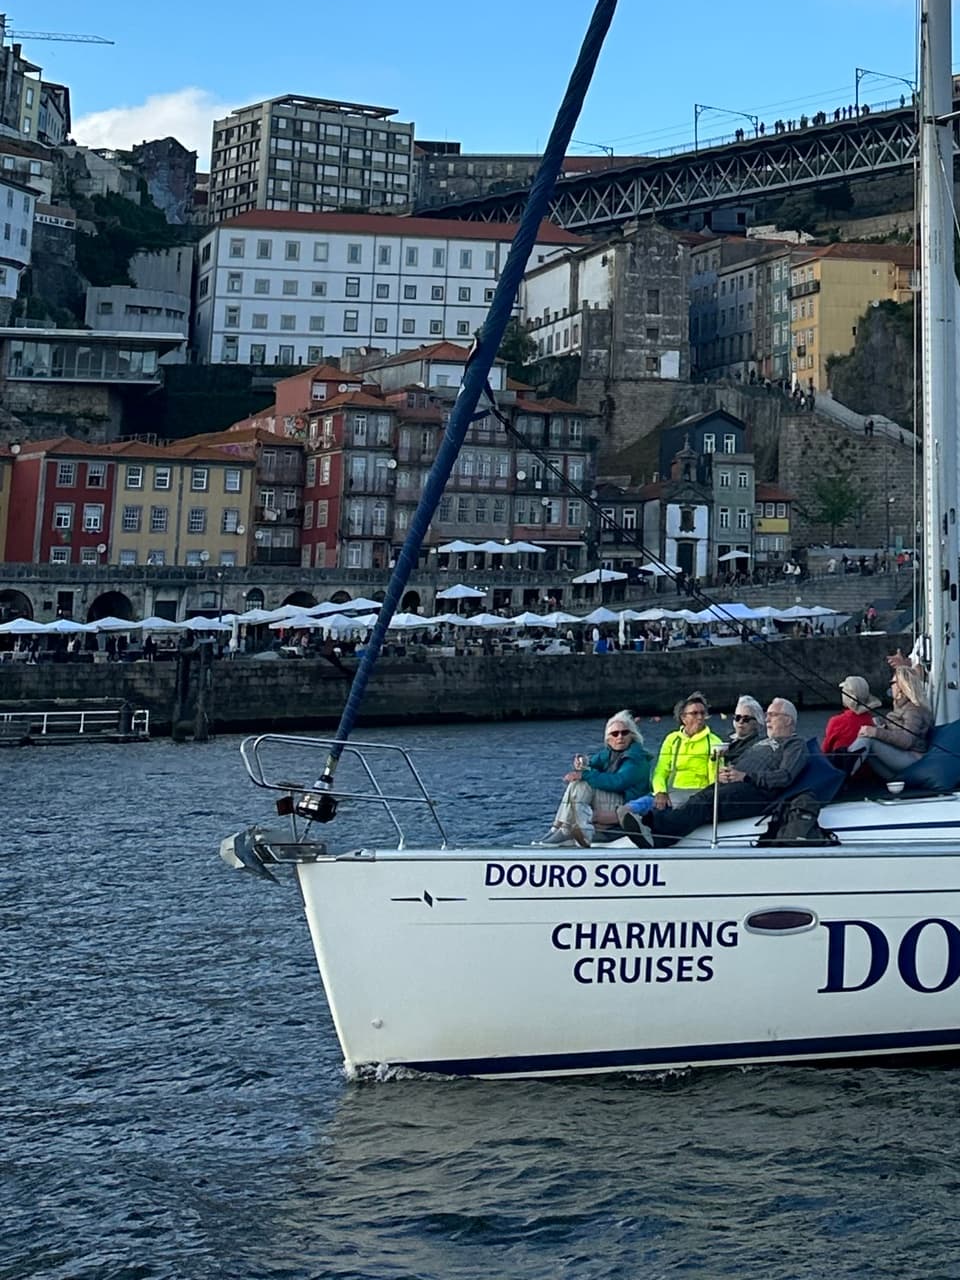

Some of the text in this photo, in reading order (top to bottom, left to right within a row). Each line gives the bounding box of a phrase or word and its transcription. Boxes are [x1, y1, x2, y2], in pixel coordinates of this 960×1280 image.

[485, 864, 667, 887] DOURO SOUL
[551, 921, 739, 950] CHARMING
[573, 956, 714, 984] CRUISES
